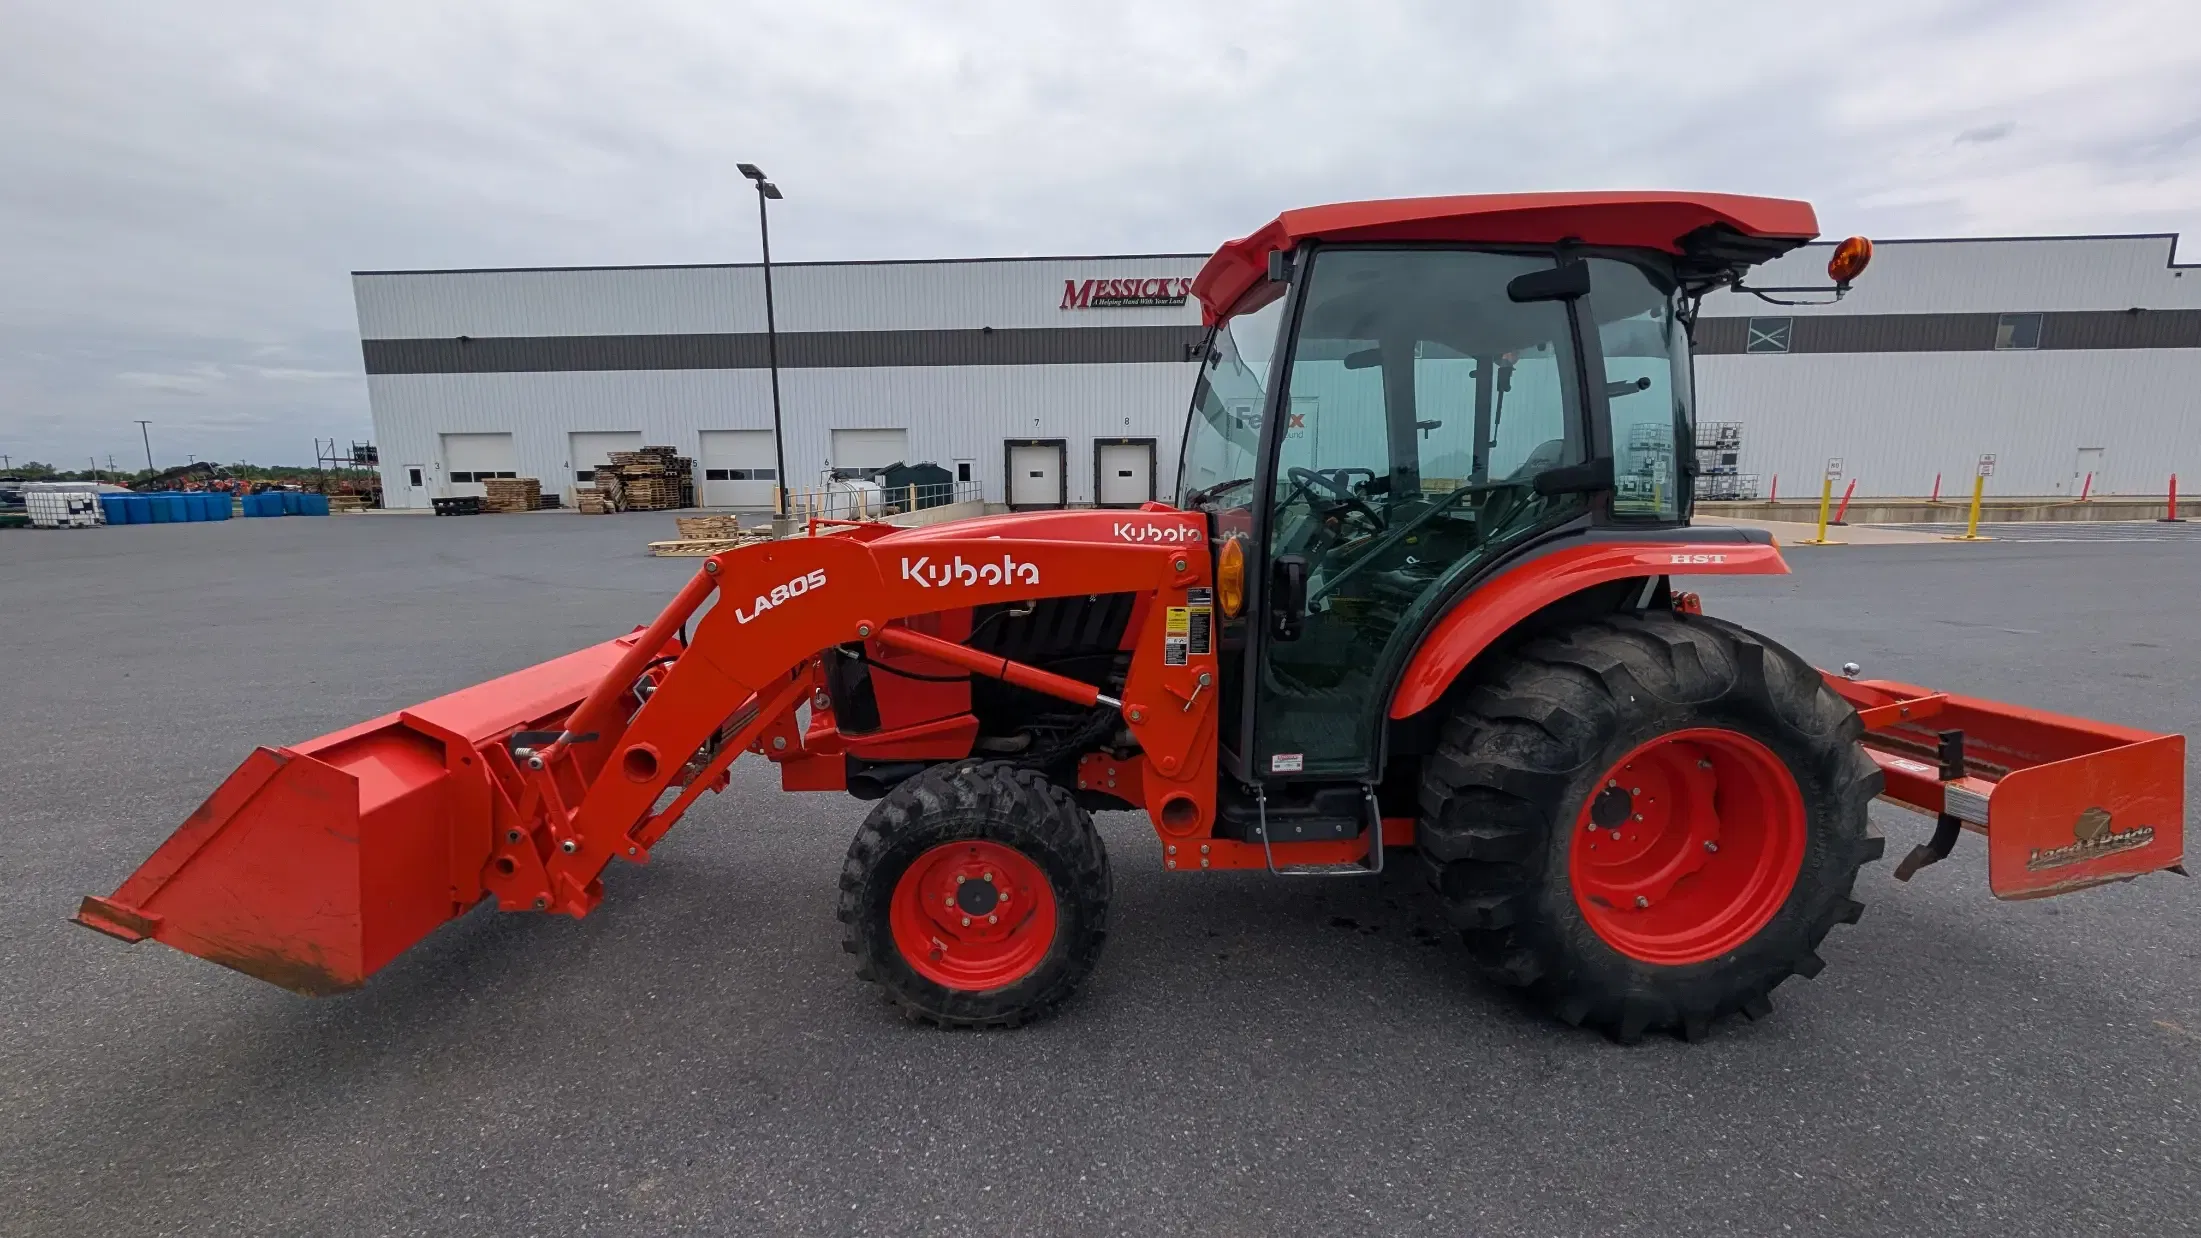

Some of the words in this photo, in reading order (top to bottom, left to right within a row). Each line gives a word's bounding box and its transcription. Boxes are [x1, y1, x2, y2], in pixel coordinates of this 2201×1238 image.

[1059, 277, 1192, 309] MESSICK'S
[1034, 418, 1040, 427] 7
[1124, 417, 1130, 426] 8
[1236, 406, 1305, 429] Fex
[435, 462, 440, 470] 3
[563, 460, 569, 469] 4
[692, 459, 698, 468] 5
[824, 458, 830, 466] 6
[1113, 522, 1203, 542] Kubota
[1669, 553, 1728, 565] HST
[901, 554, 1040, 588] Kubota
[734, 567, 828, 625] LA805
